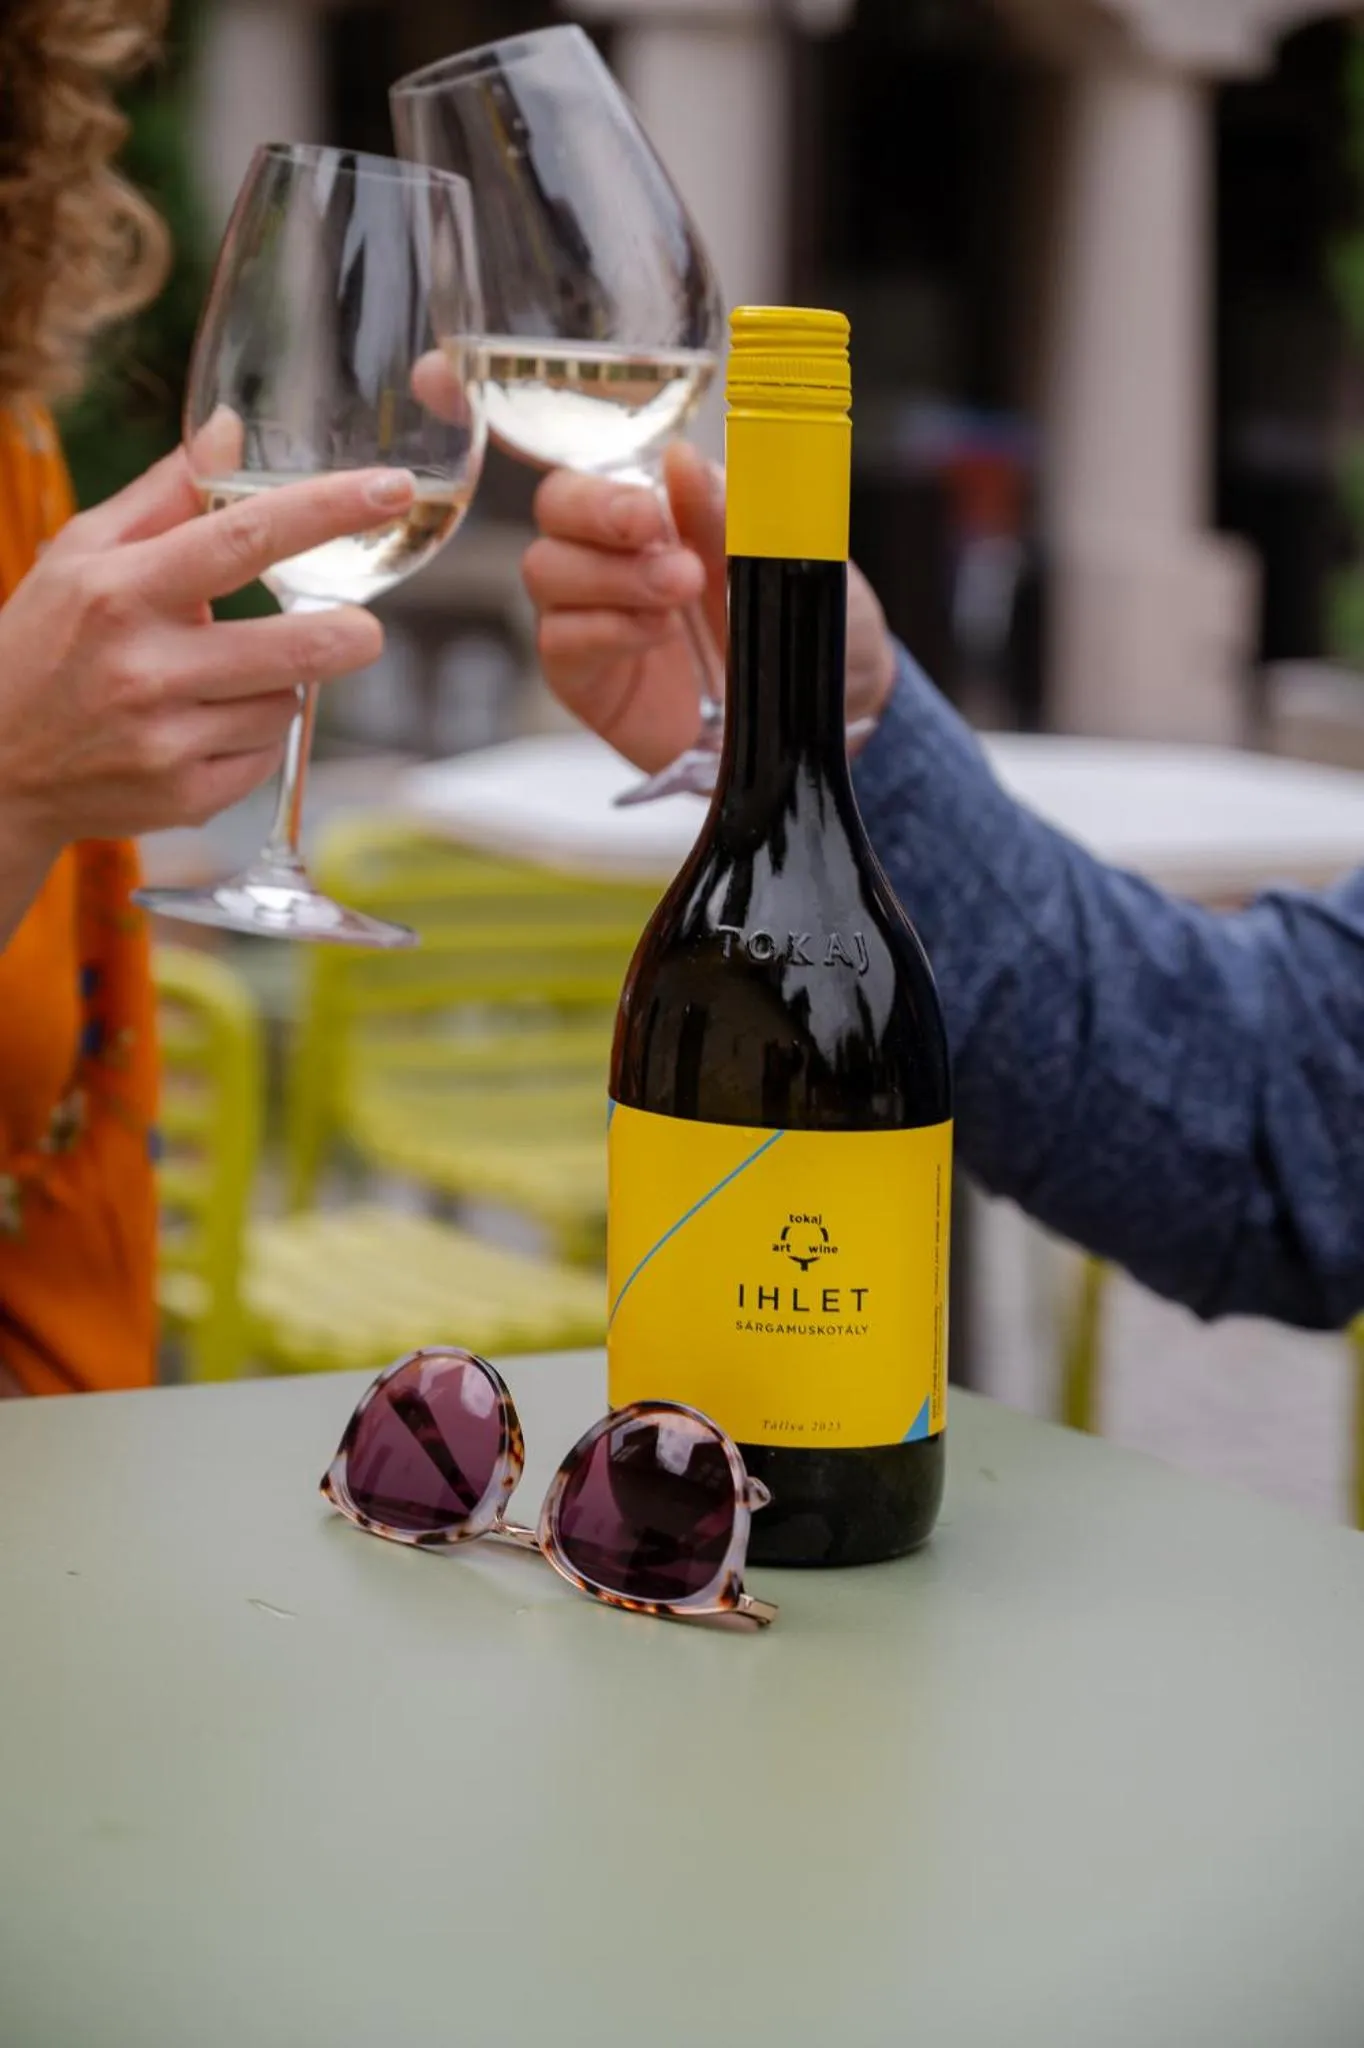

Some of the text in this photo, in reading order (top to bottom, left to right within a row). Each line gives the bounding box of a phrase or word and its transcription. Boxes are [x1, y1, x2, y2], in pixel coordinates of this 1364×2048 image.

[717, 924, 870, 976] TOKAJ
[789, 1213, 822, 1225] tokaj
[771, 1243, 839, 1255] art wine
[738, 1283, 869, 1312] IHLET
[735, 1319, 869, 1336] SÁRGAMUSKOTÁLY
